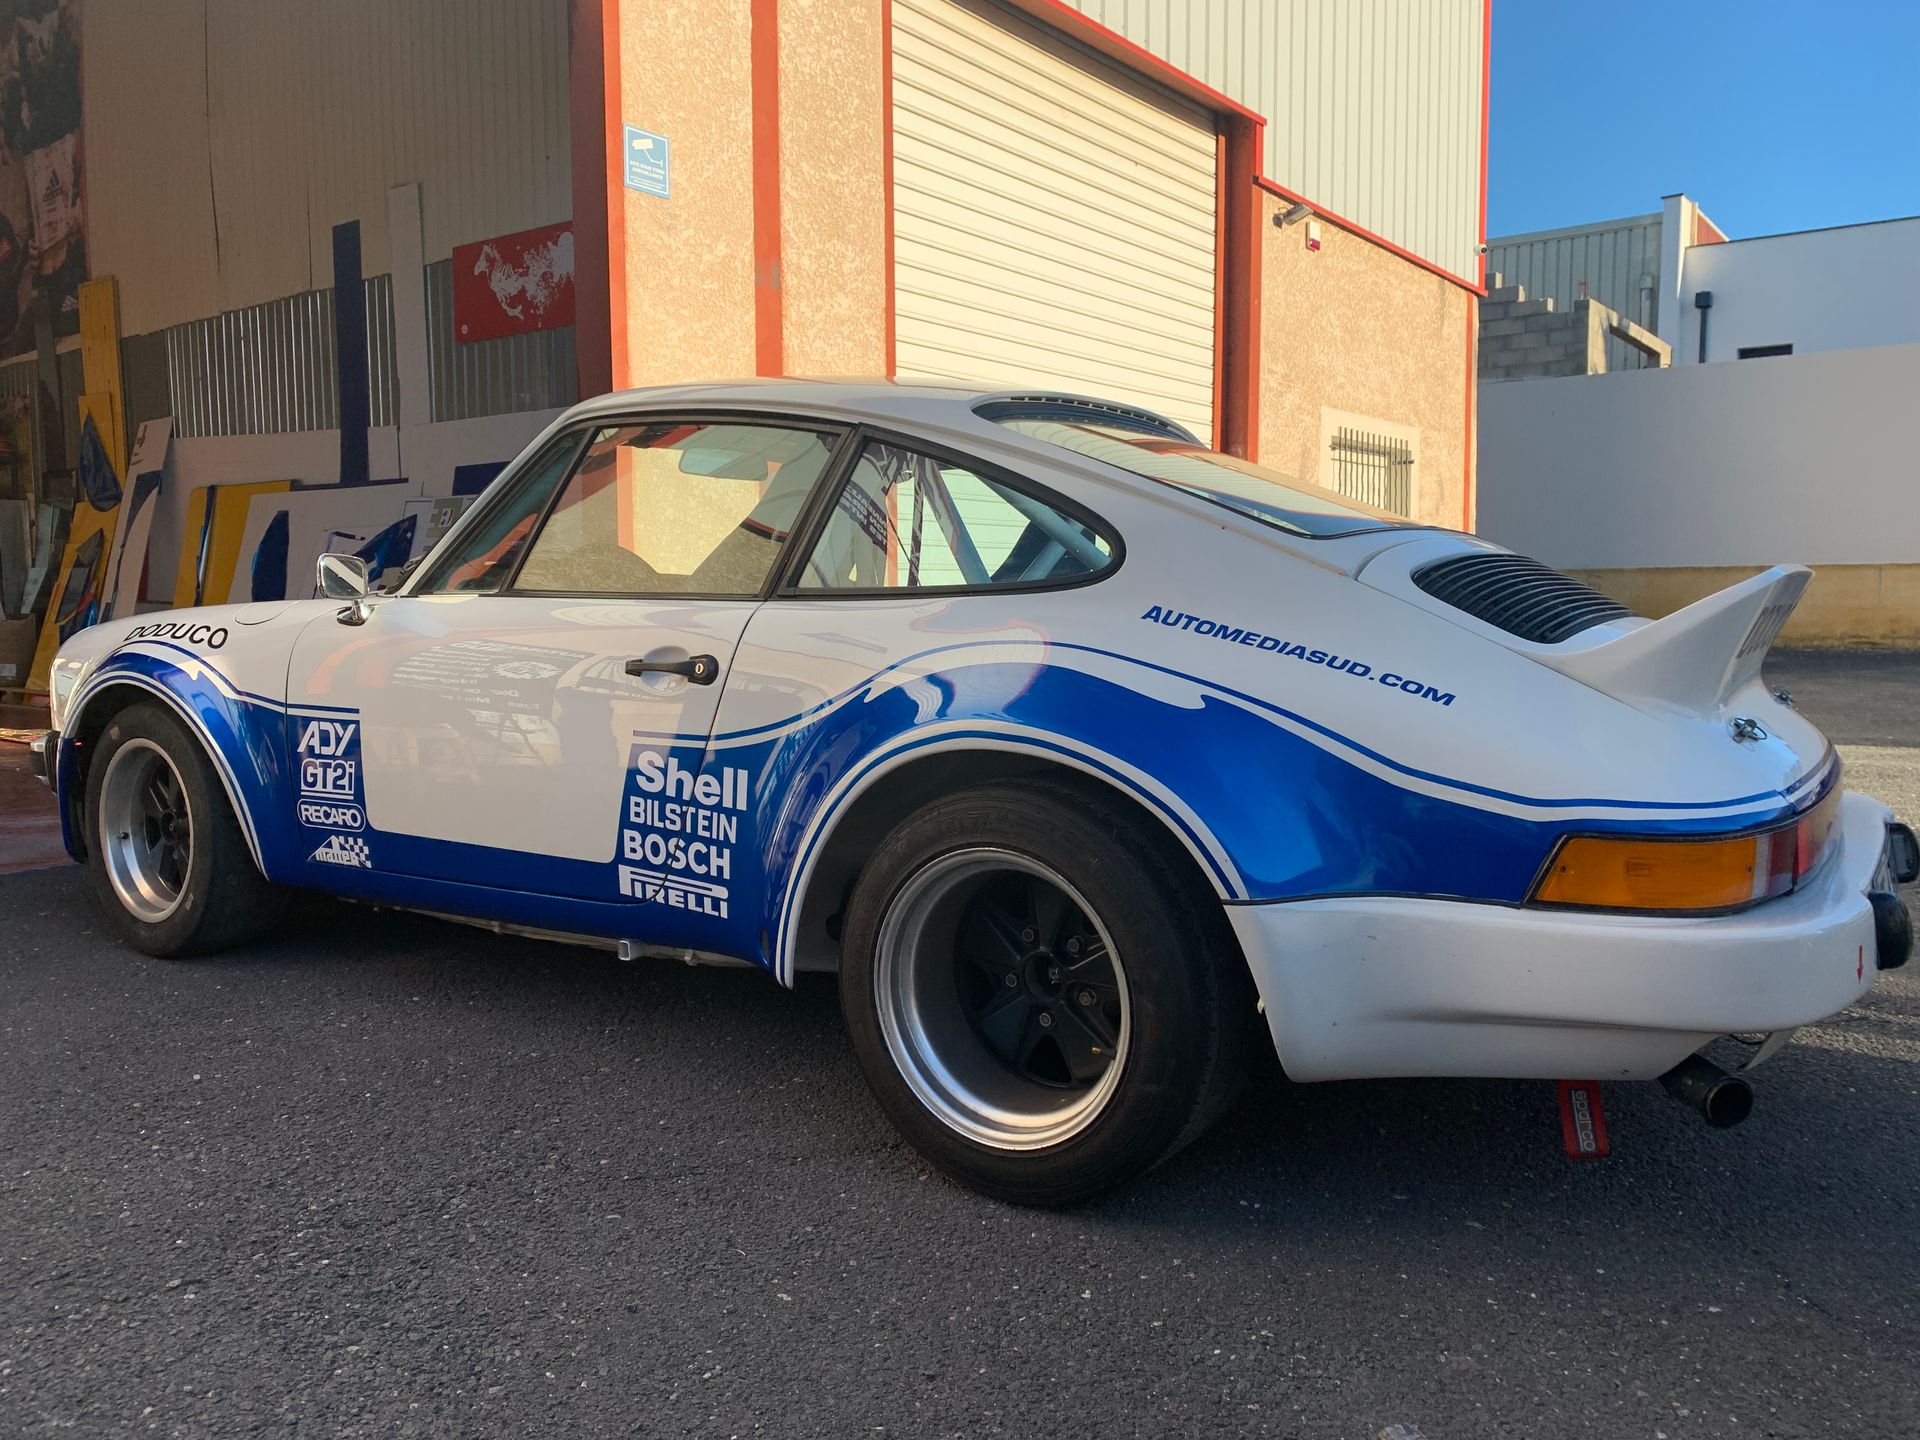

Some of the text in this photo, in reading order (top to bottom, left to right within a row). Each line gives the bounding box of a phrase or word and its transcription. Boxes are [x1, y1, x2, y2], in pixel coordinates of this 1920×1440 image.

[124, 622, 228, 650] DODUCO
[1140, 605, 1456, 706] AUTOMEDIASUD.COM
[301, 758, 354, 794] GT2i
[636, 750, 748, 811] Shell
[301, 804, 362, 828] RECARO
[629, 796, 737, 844] BILSTEIN
[623, 828, 731, 880] BOSCH
[618, 864, 729, 919] PIRELLI
